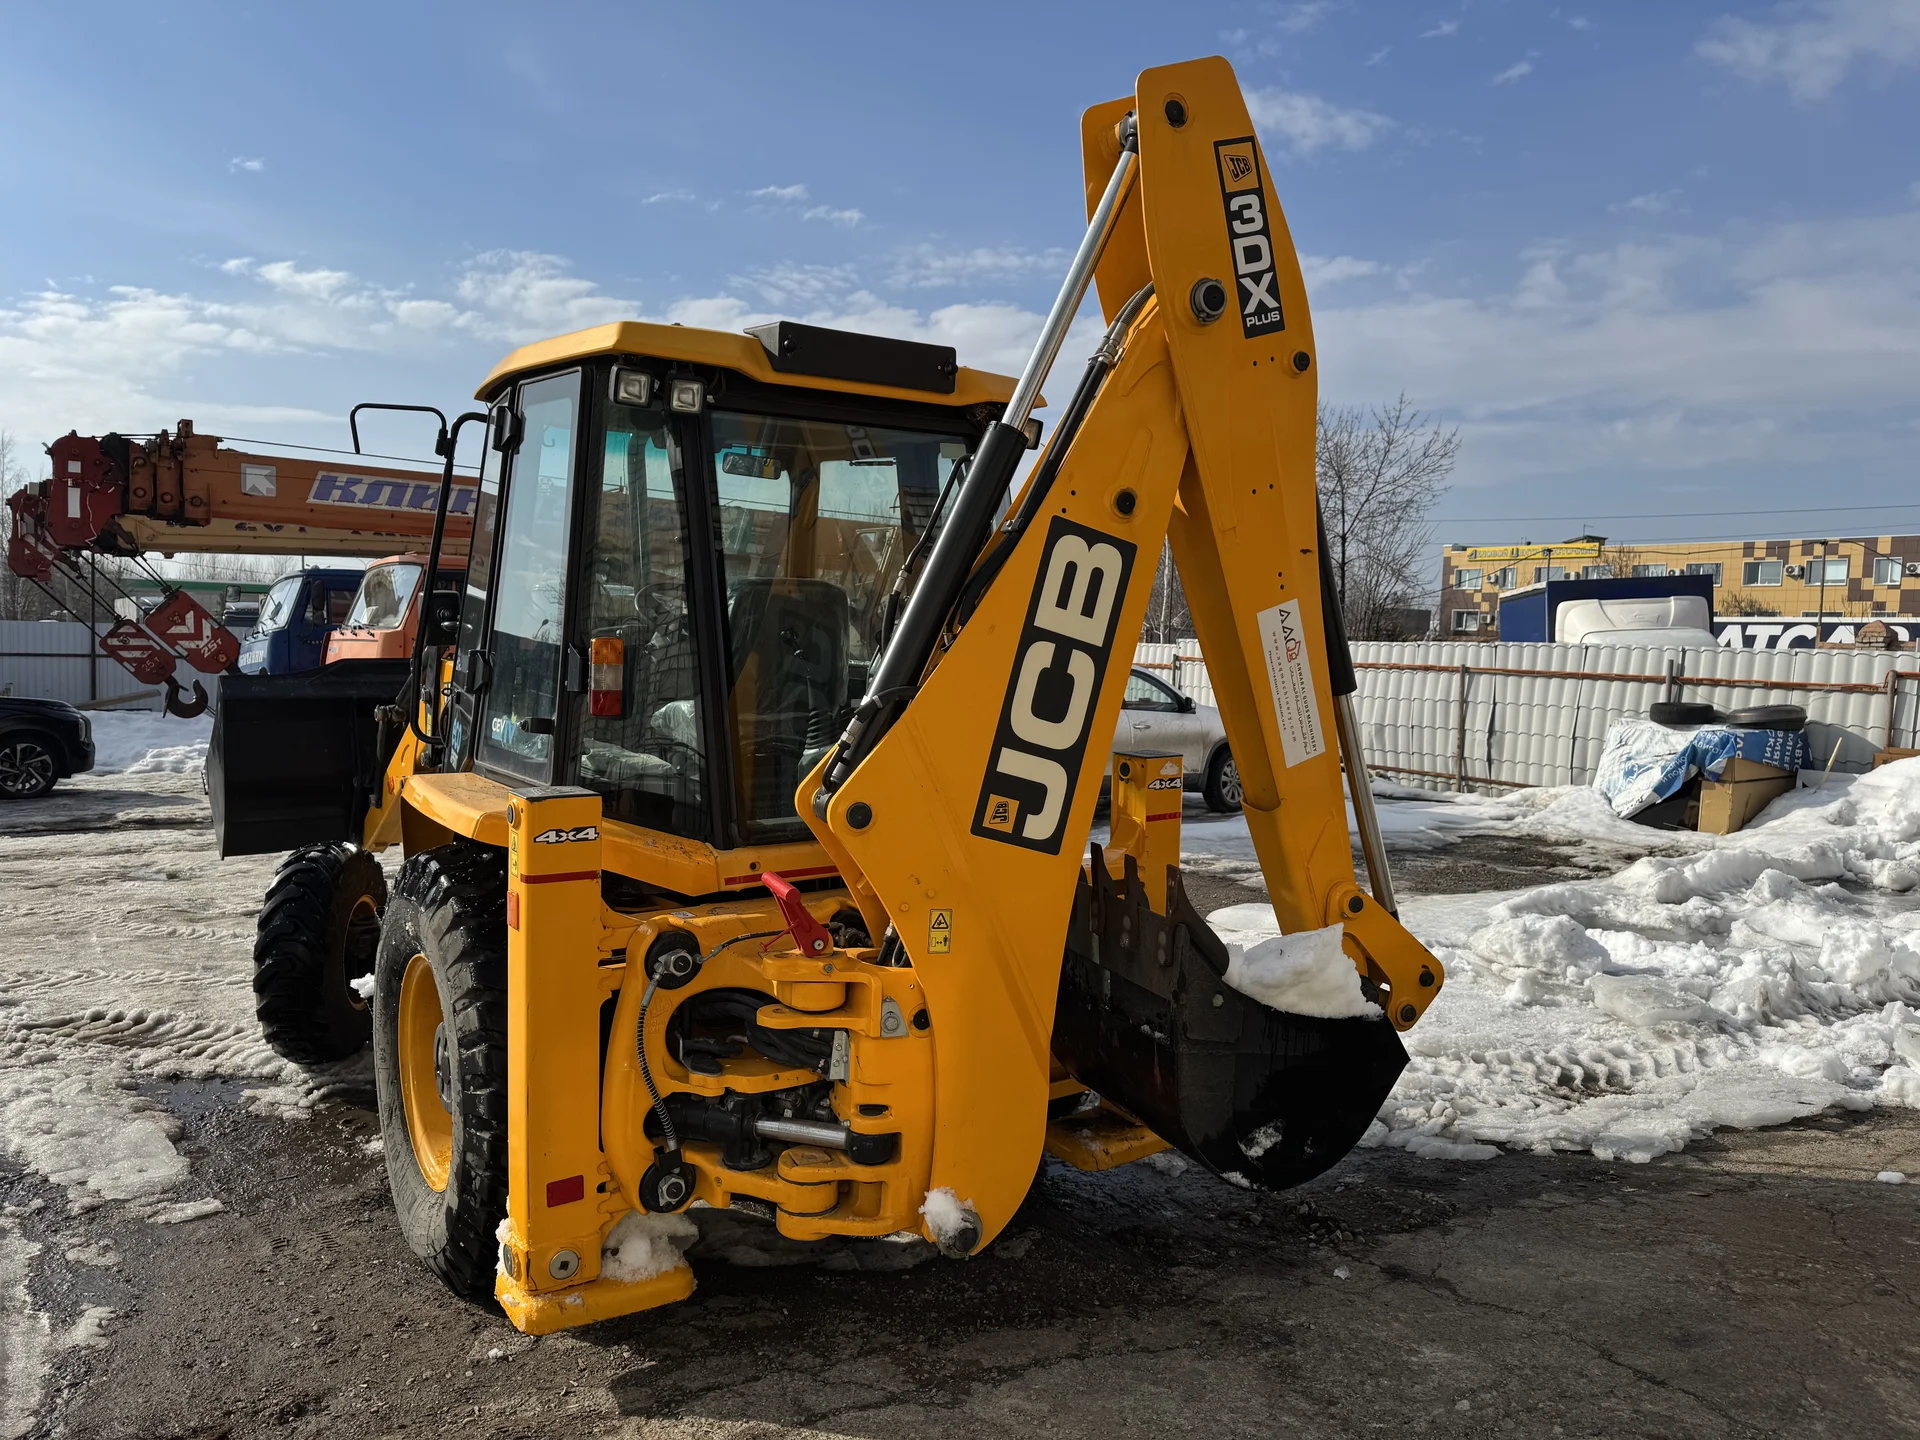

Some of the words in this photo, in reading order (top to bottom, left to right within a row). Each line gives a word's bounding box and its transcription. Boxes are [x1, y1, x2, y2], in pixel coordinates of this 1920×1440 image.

[1229, 156, 1250, 179] JCB
[1230, 194, 1280, 315] 3DX
[1246, 311, 1281, 327] PLUS
[996, 535, 1122, 841] JCB
[1296, 663, 1305, 686] ANWAR
[1301, 686, 1307, 695] AL
[1306, 714, 1317, 752] MACHINERY
[1148, 778, 1182, 790] 4x4
[993, 801, 1008, 823] JCB
[535, 827, 599, 844] 4x4
